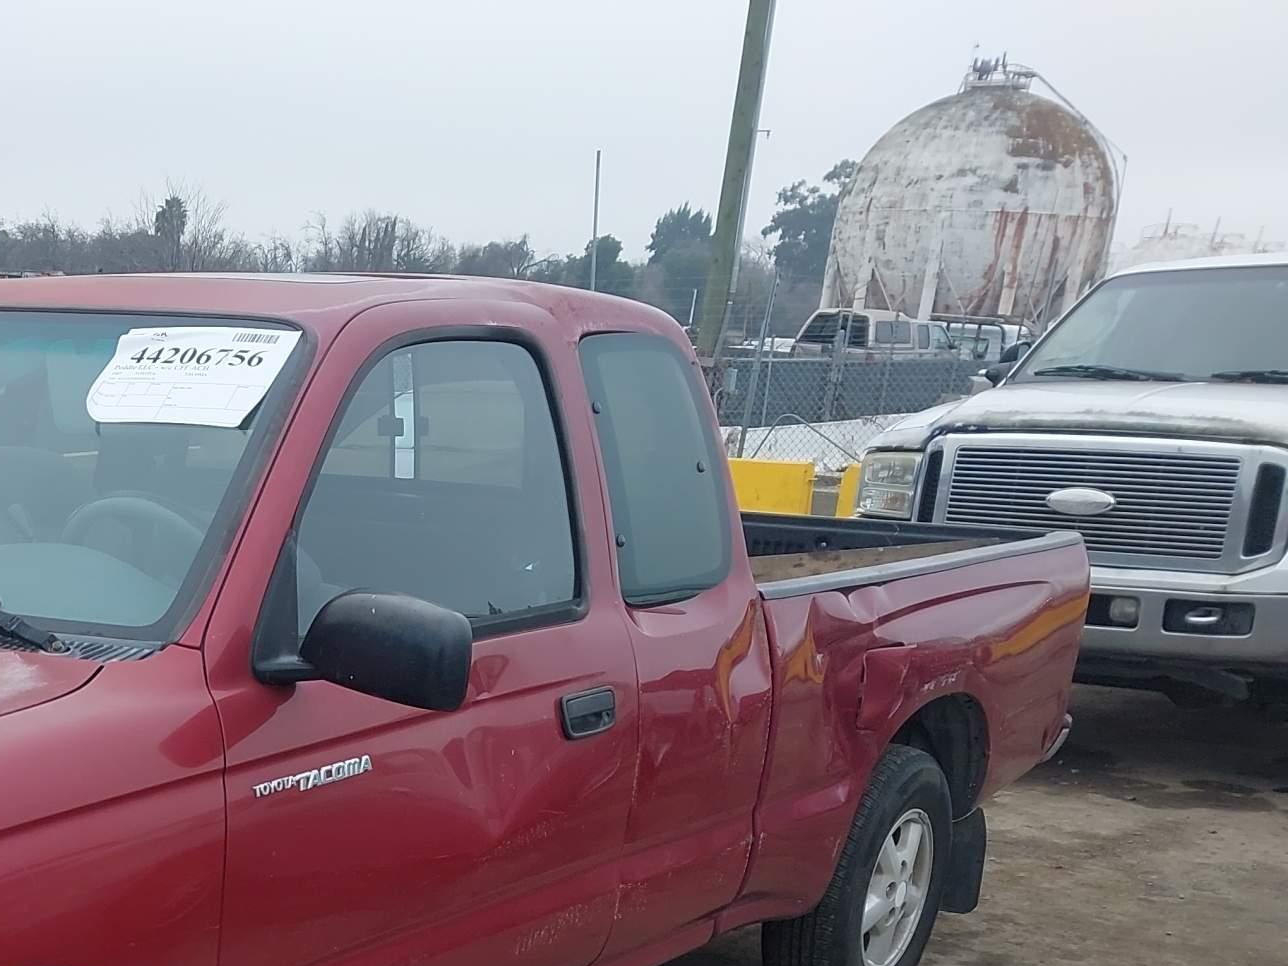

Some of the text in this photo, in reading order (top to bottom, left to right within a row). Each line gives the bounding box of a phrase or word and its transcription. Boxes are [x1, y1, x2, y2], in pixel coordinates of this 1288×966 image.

[130, 346, 265, 367] 44206756
[252, 754, 373, 797] TOYOTA TACOMA
